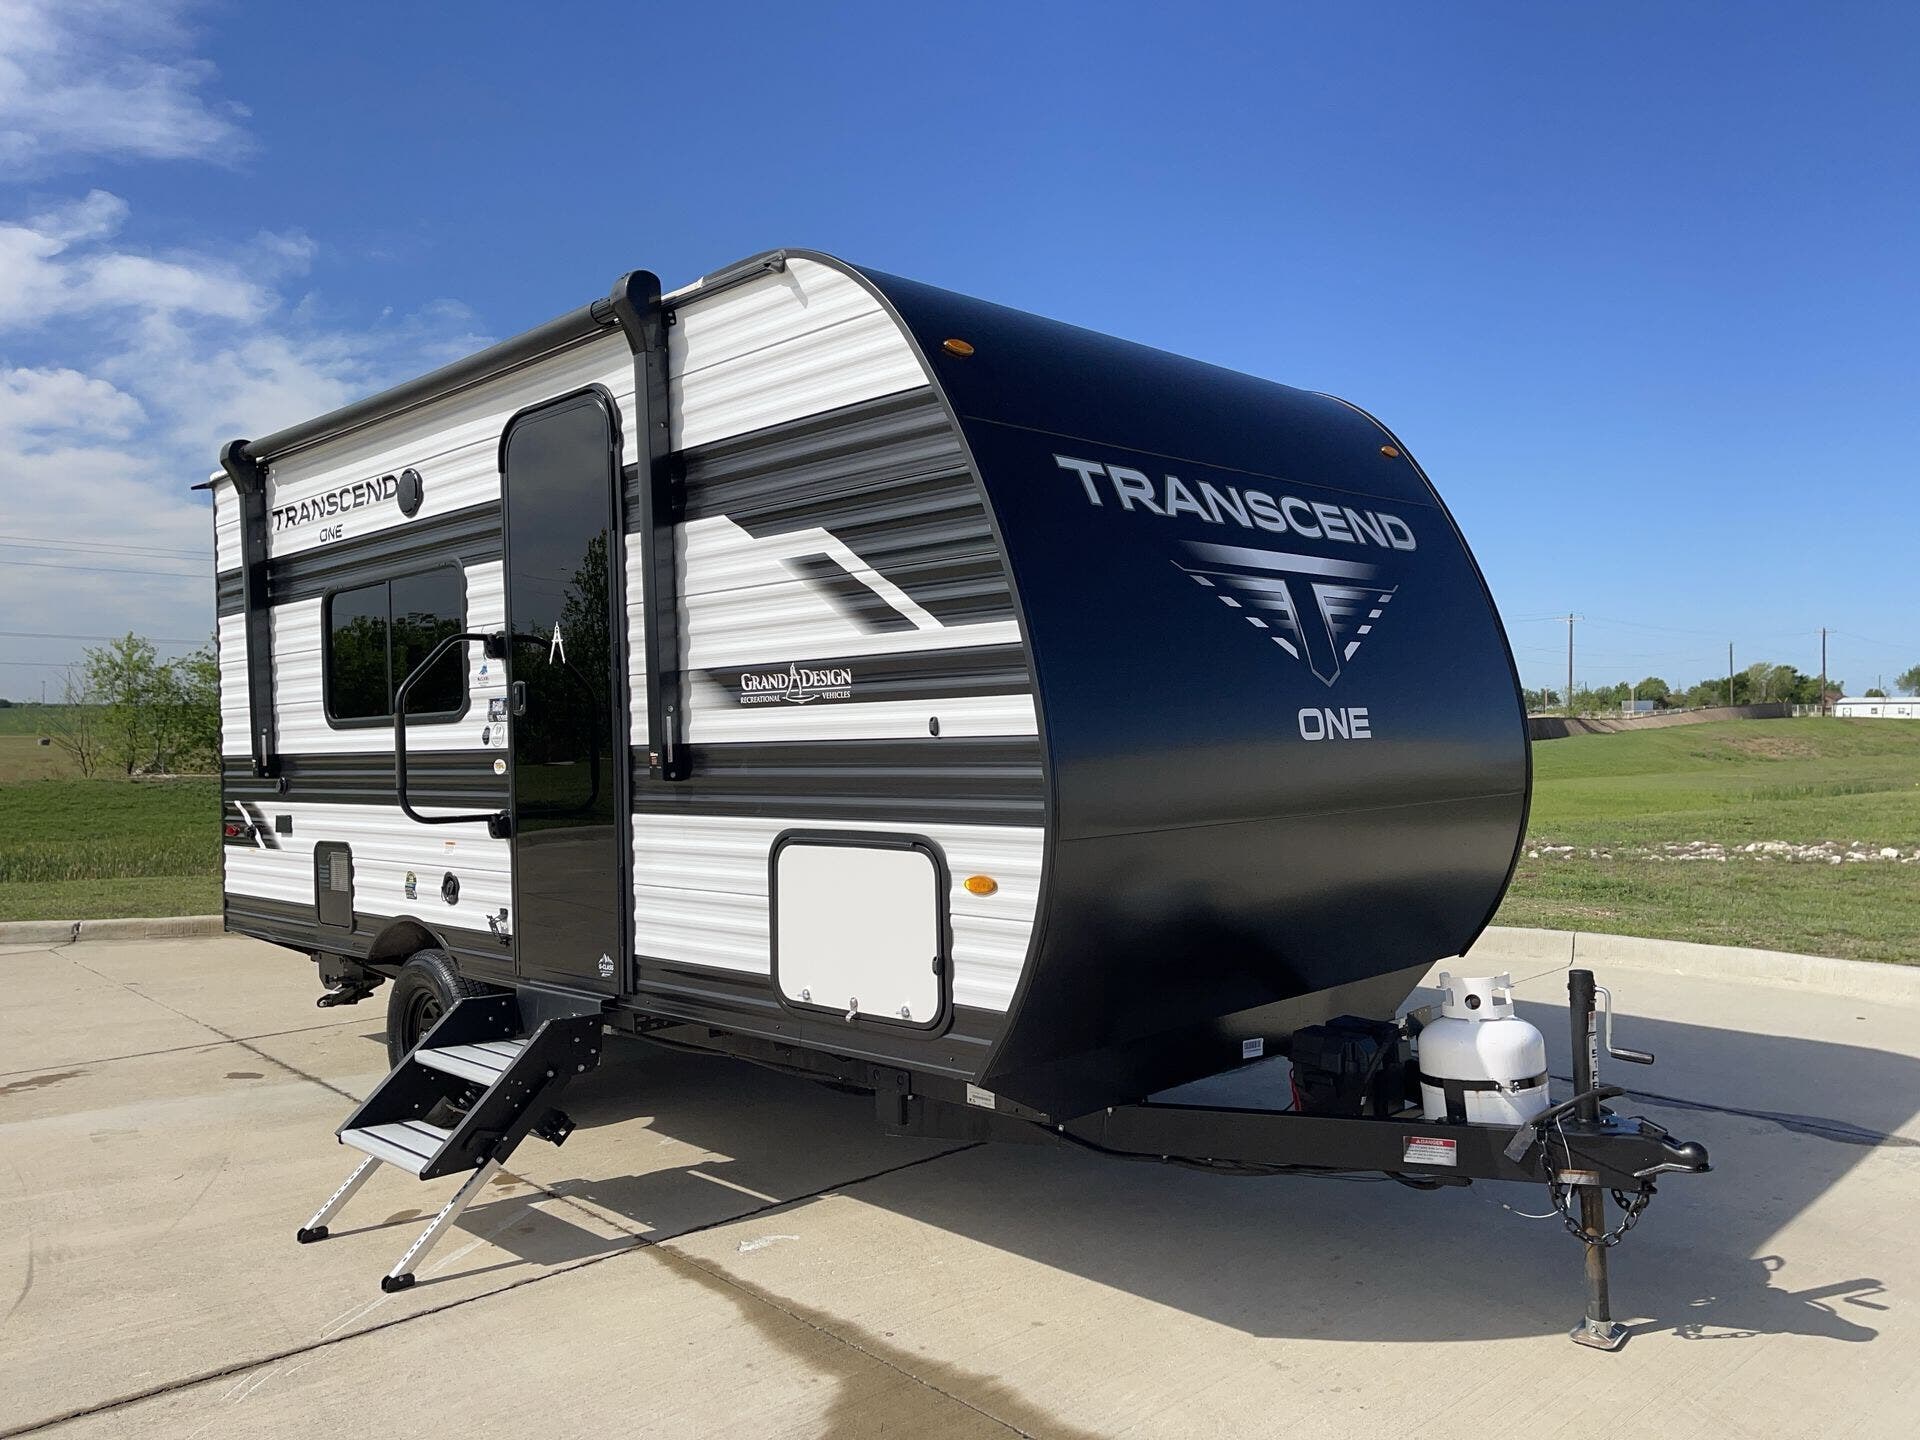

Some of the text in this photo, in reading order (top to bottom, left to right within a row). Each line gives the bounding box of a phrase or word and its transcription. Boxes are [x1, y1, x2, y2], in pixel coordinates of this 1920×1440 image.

[272, 474, 398, 530] TRANSCEND
[1052, 453, 1417, 551] TRANSCEND
[320, 524, 343, 542] ONE
[741, 669, 852, 690] GRAND DESIGN
[740, 691, 850, 704] RECREATIONAL VEHICLES
[1298, 707, 1372, 741] ONE
